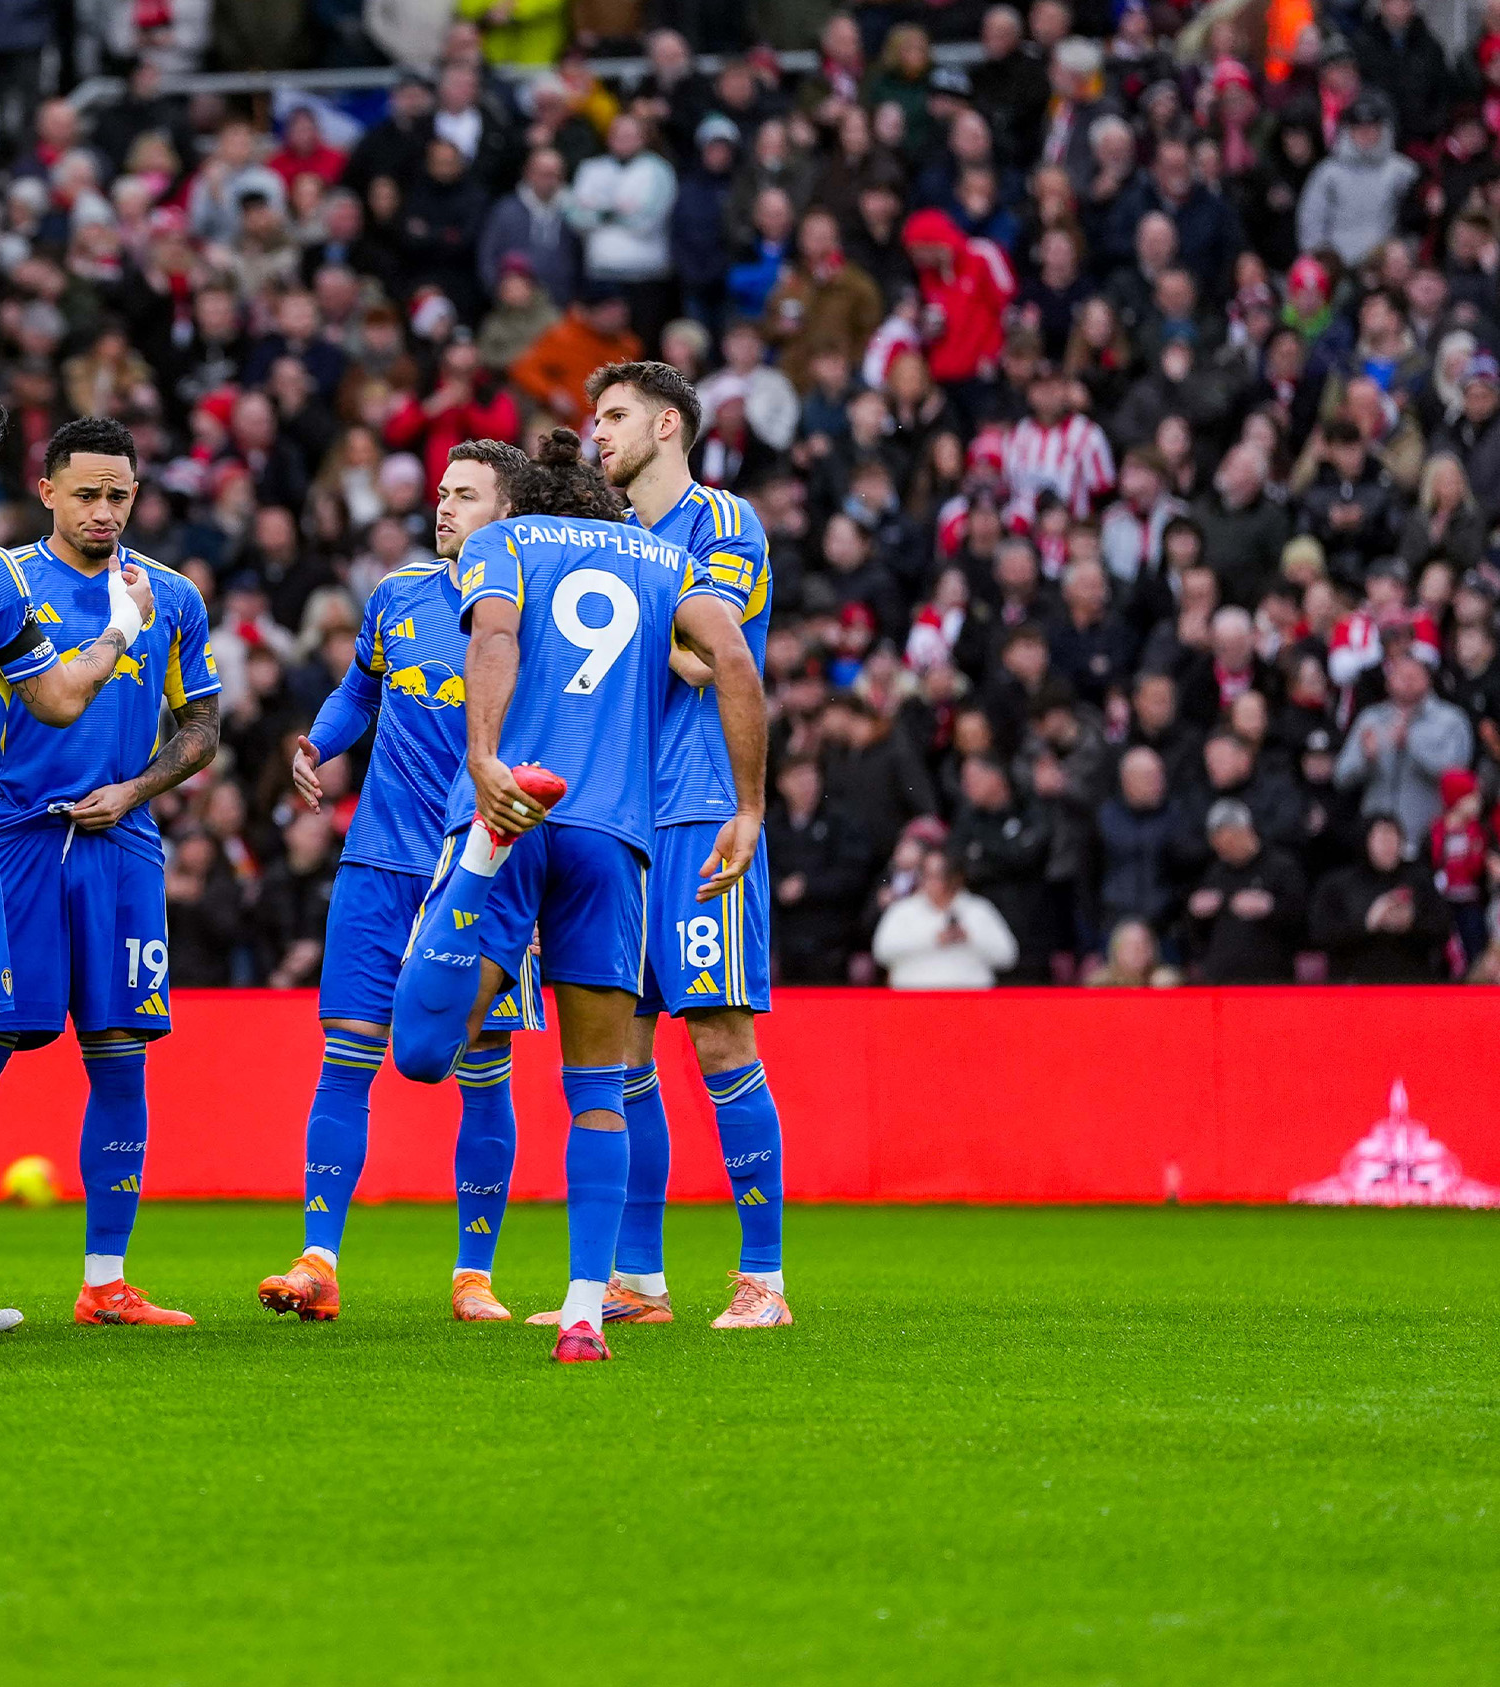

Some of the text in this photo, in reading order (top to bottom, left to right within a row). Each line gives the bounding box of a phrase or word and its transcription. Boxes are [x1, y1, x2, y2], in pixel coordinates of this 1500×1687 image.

[514, 524, 680, 571] CALVERT-LEWIN
[552, 568, 640, 695] 9
[125, 937, 169, 990] 19
[675, 915, 722, 971] 18
[305, 1162, 342, 1176] UFC
